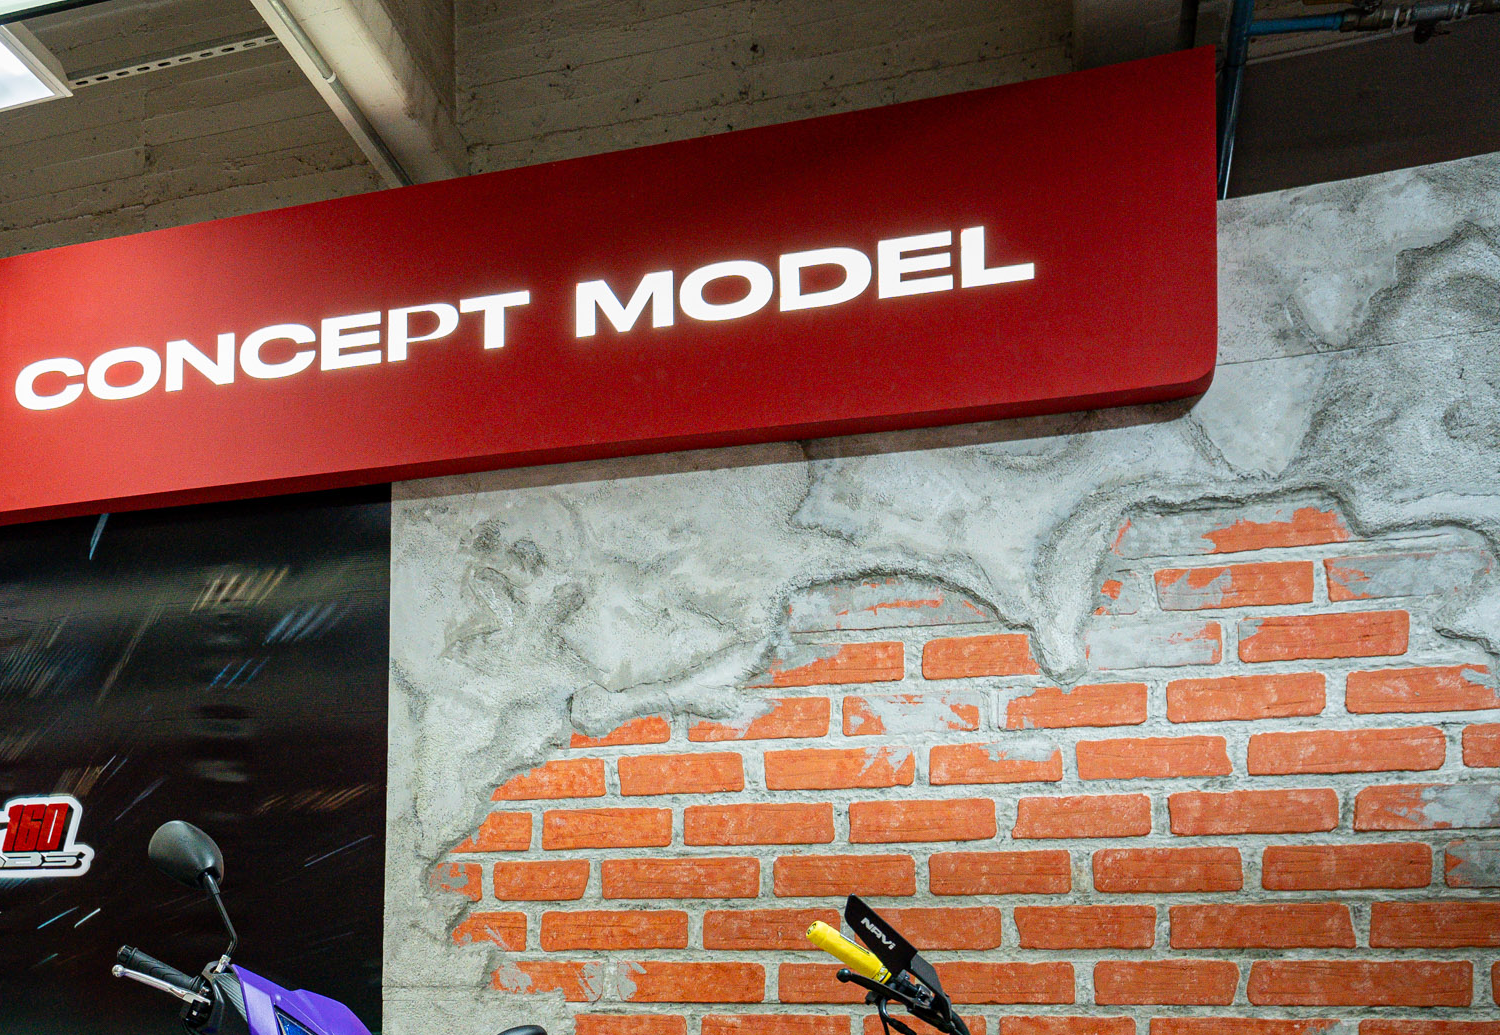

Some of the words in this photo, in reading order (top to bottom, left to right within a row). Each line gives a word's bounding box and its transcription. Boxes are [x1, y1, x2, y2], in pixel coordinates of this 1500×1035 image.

[15, 290, 530, 411] CONCEPT
[576, 226, 1035, 338] MODEL
[2, 802, 73, 852] 160
